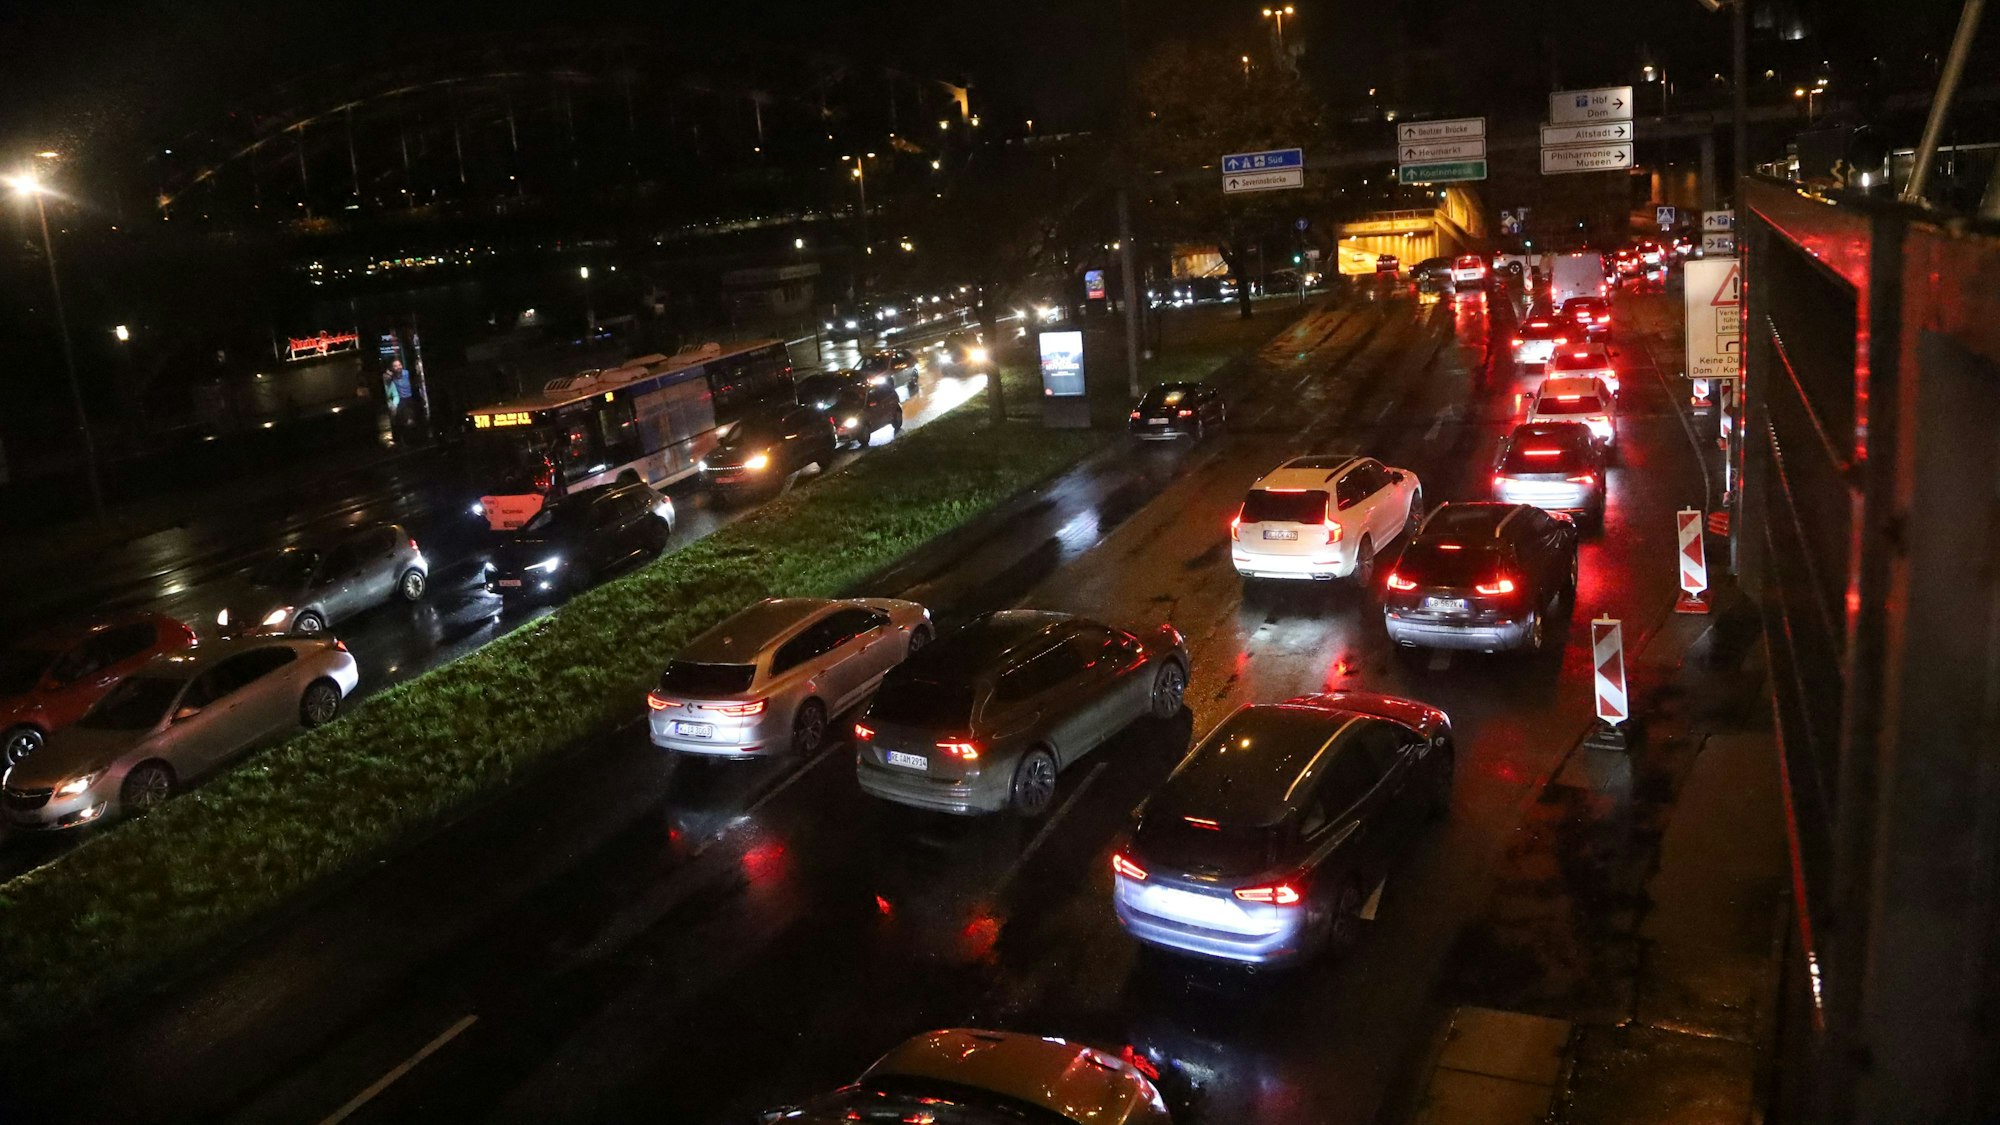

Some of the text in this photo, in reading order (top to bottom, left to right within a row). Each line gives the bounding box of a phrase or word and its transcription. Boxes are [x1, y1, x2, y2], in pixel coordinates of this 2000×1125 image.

[1592, 96, 1607, 105] Hbf
[1587, 109, 1608, 118] Dom
[1418, 125, 1468, 136] Deutzer Brücke
[1575, 130, 1611, 139] Altstadt
[1418, 146, 1461, 157] Heumarkt
[1551, 150, 1611, 160] Philharmonie
[1267, 155, 1283, 165] Süd
[1576, 158, 1611, 168] Museen
[1241, 176, 1286, 188] Severinsbrücke
[1699, 356, 1723, 364] Keine
[1693, 366, 1712, 374] Dom
